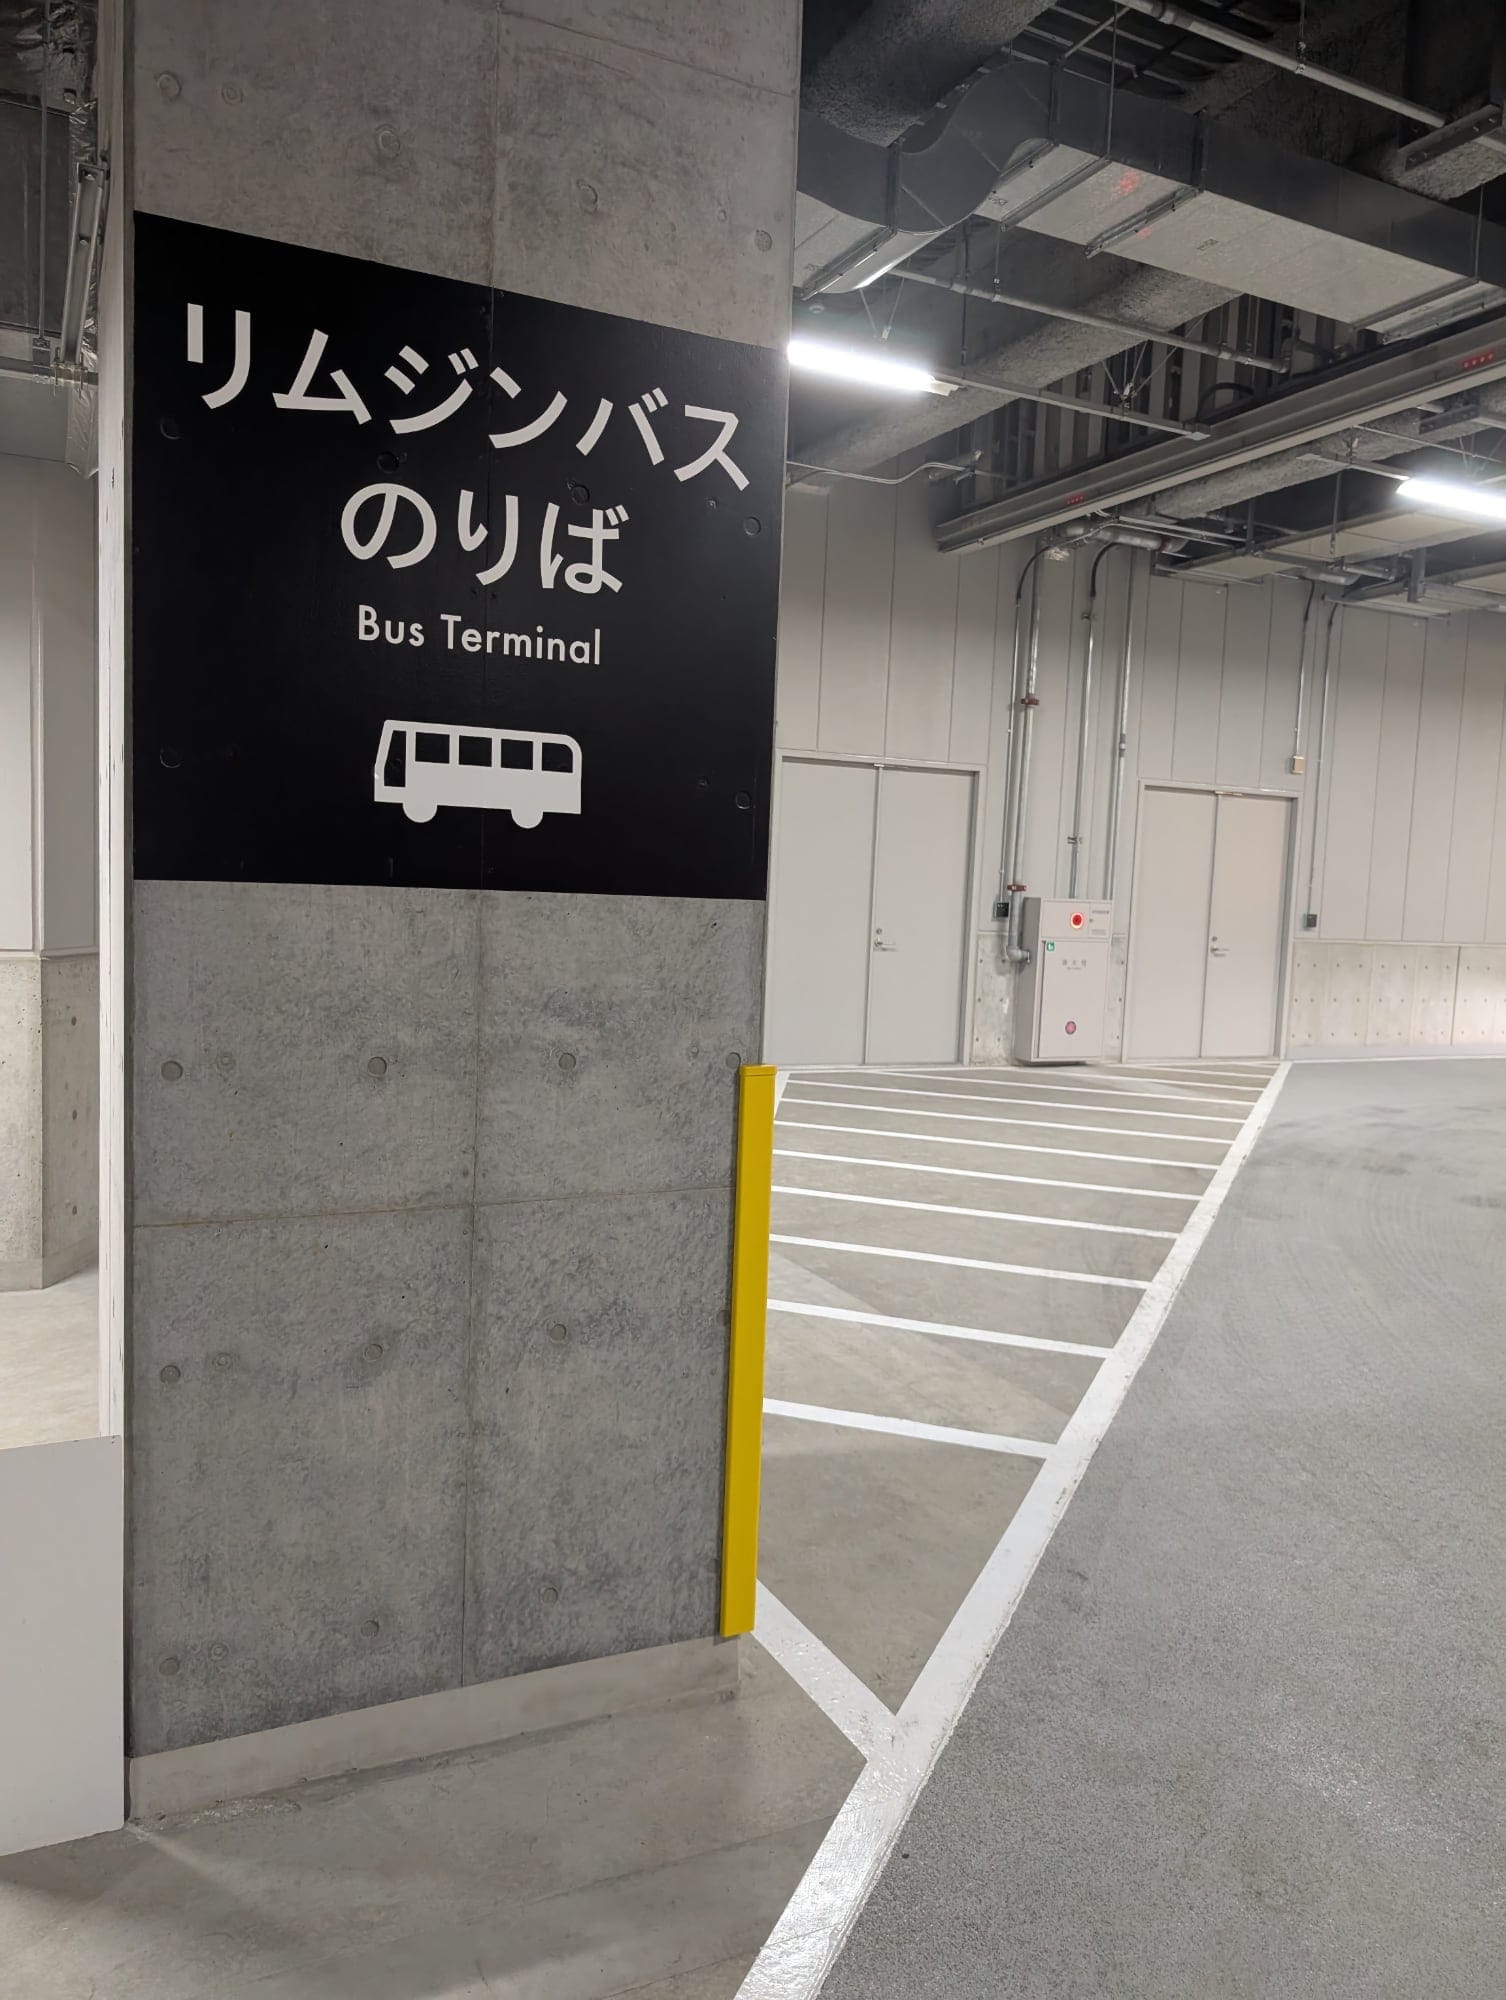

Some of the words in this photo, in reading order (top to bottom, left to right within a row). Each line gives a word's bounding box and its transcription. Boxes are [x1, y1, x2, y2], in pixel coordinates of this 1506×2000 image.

[187, 302, 750, 492] リムジンバス
[340, 482, 630, 594] のりば
[358, 604, 425, 647] Bus
[440, 613, 601, 665] Terminal
